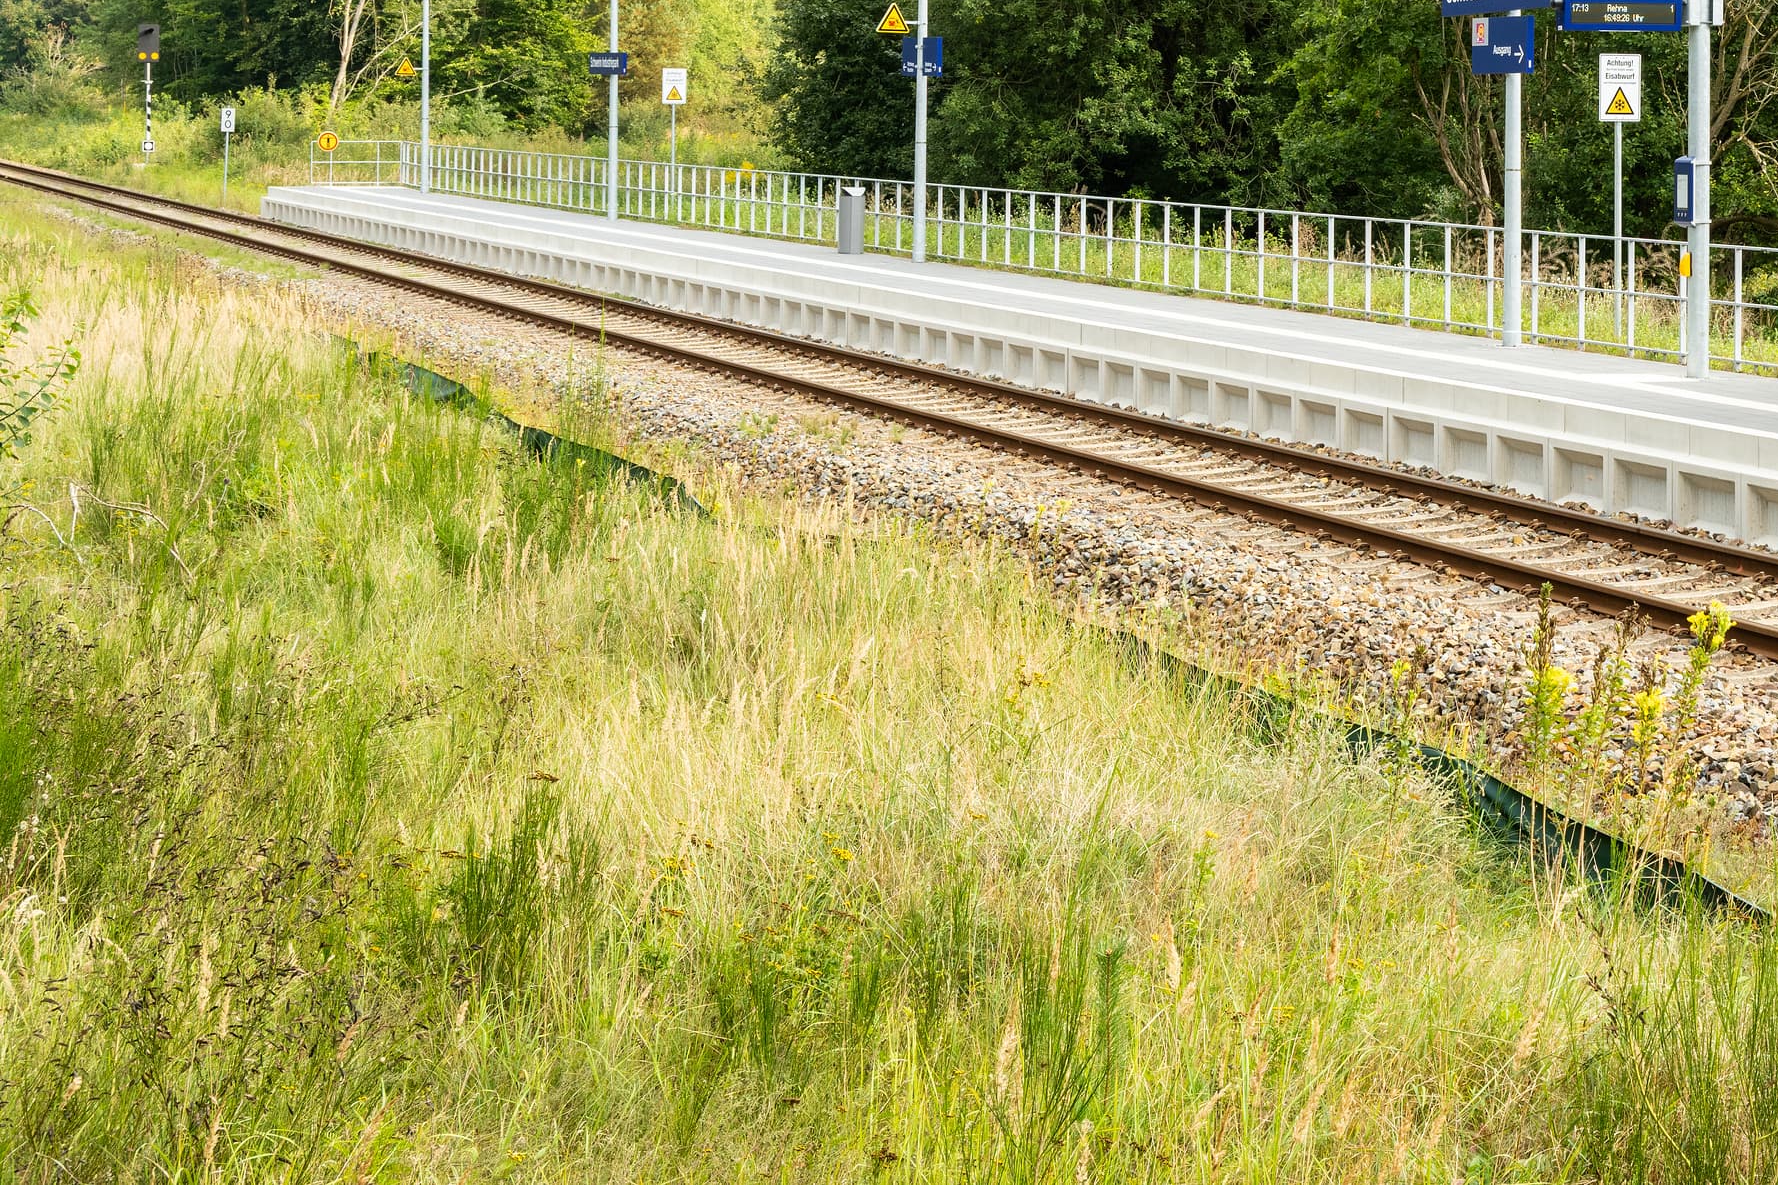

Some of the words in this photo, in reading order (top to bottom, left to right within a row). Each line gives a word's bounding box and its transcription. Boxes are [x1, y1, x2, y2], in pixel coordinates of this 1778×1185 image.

[1572, 3, 1590, 13] 17:13
[1606, 3, 1628, 13] Rehna
[1670, 4, 1675, 14] 1
[1632, 14, 1645, 23] Uhr
[1606, 59, 1634, 68] Achtung!
[1605, 72, 1635, 80] Eisabwurf
